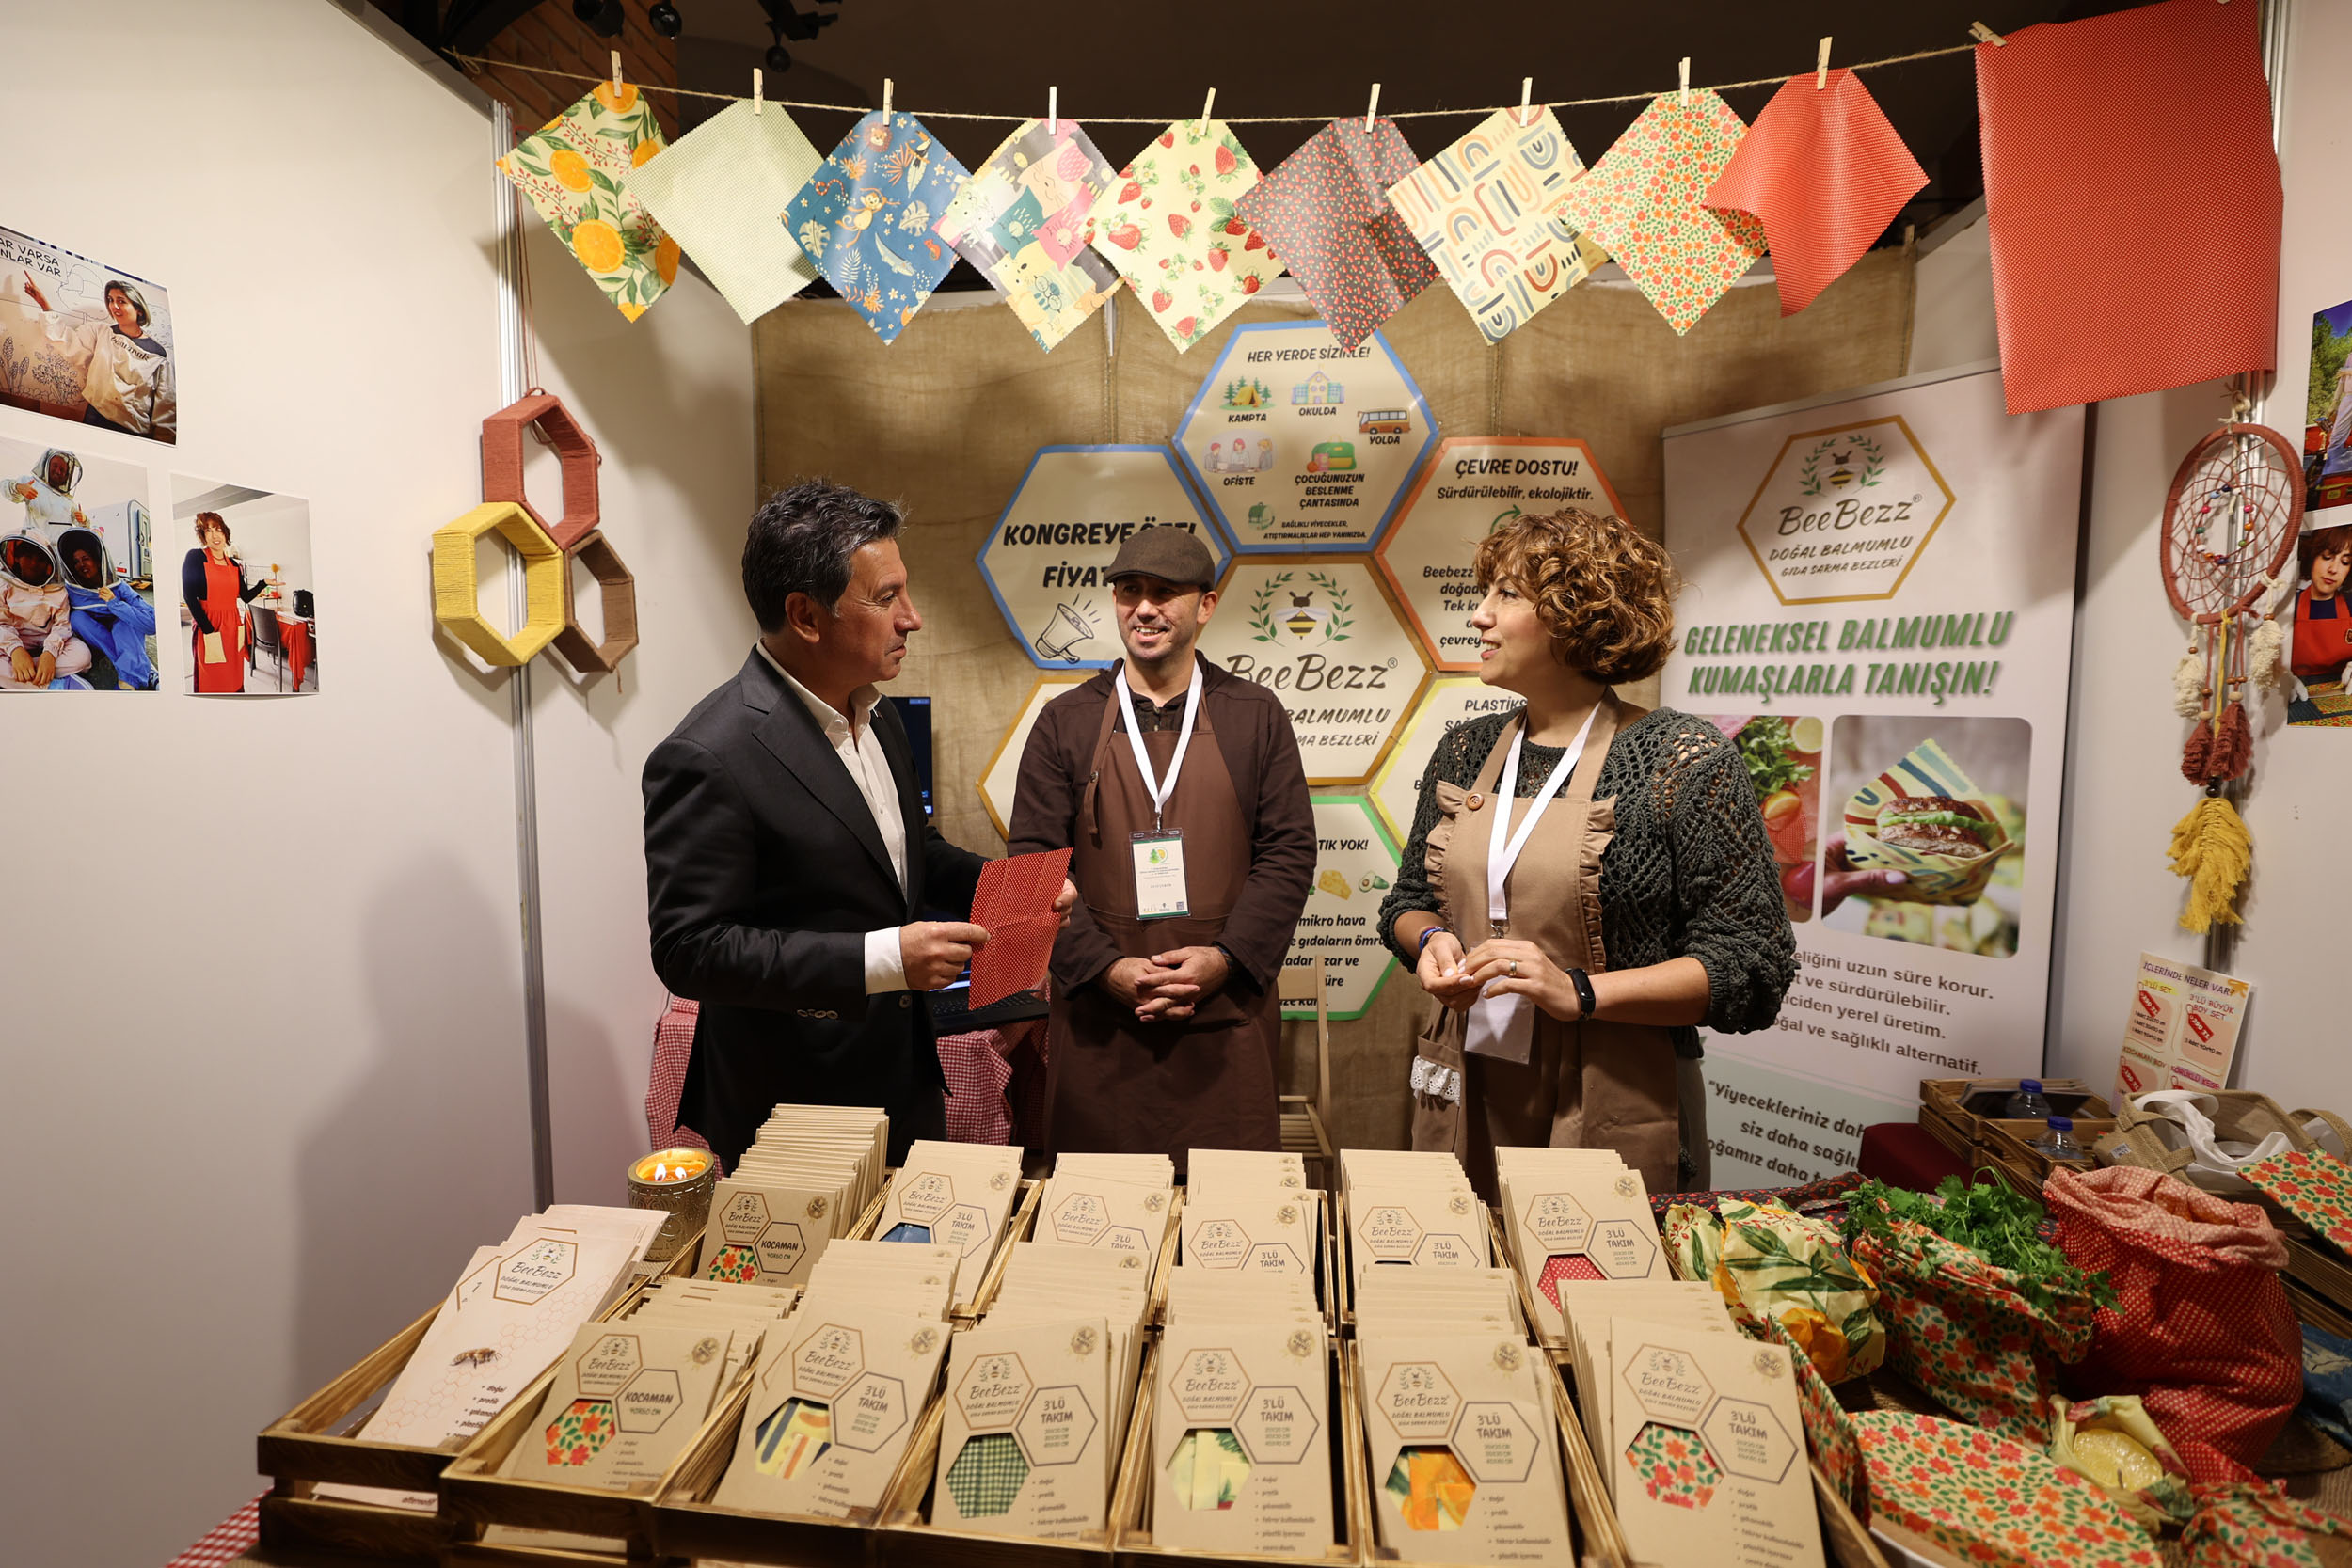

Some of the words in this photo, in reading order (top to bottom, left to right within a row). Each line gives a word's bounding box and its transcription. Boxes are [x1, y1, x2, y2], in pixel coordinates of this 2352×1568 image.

[18, 245, 59, 266] VARSA
[38, 262, 62, 277] VAR
[1248, 352, 1273, 363] HER
[1277, 349, 1316, 361] YERDE
[1228, 414, 1266, 423] KAMPTA
[1298, 407, 1337, 416] OKULDA
[1369, 436, 1401, 445] YOLDA
[1456, 459, 1512, 478] ÇEVRE
[1515, 460, 1579, 476] DOSTU!
[1223, 475, 1255, 486] OFİSTE
[1295, 472, 1365, 484] ÇOCUĞUNUZUN
[1305, 486, 1354, 496] BESLENME
[1438, 485, 1526, 500] Sürdürülebilir,
[1528, 486, 1594, 501] ekolojiktir.
[1299, 498, 1359, 509] ÇANTASINDA
[1003, 522, 1135, 546] KONGREYE
[1769, 544, 1817, 562] DOĞAL
[1820, 536, 1914, 557] BALMUMLU
[1423, 566, 1474, 578] Beebezz
[1781, 565, 1807, 577] GIDA
[1810, 562, 1847, 574] SARMA
[1851, 555, 1903, 571] BEZLERİ
[1443, 600, 1464, 611] Tek
[1684, 621, 1829, 655] GELENEKSEL
[1837, 611, 2014, 651] BALMUMLU
[1688, 664, 1855, 704] KUMAŞLARLA
[1864, 661, 2000, 705] TANIŞIN!
[1287, 708, 1391, 724] BALMUMLU
[1318, 732, 1380, 746] BEZLERİ
[1340, 840, 1369, 850] YOK!
[1298, 914, 1334, 927] mikro
[1336, 914, 1366, 926] hava
[1298, 935, 1352, 949] gıdaların
[1282, 955, 1313, 966] adar
[1345, 958, 1359, 966] ve
[1846, 961, 1887, 978] uzun
[1894, 969, 1932, 987] süre
[1939, 975, 1994, 999] korur.
[2184, 974, 2209, 988] NELER
[2212, 984, 2235, 996] VAR?
[1805, 976, 1823, 988] ve
[1829, 981, 1950, 1015] sürdürülebilir.
[2192, 1004, 2207, 1013] BOY
[2211, 1010, 2225, 1020] SET
[2209, 999, 2234, 1014] BÜYÜK
[1837, 1005, 1878, 1023] yerel
[1883, 1014, 1946, 1038] üretim.
[1808, 1024, 1826, 1037] ve
[1831, 1029, 1890, 1053] sağlıklı
[1896, 1044, 1982, 1075] alternatif.
[2153, 1058, 2166, 1068] BOY
[1740, 1120, 1764, 1137] siz
[1767, 1129, 1809, 1152] daha
[1767, 1157, 1809, 1182] daha
[909, 1191, 945, 1203] BeeBezz
[729, 1212, 762, 1223] BeeBezz
[1062, 1212, 1100, 1225] BeeBezz
[1538, 1217, 1581, 1227] BeeBezz
[952, 1221, 975, 1230] TAKIM
[1372, 1227, 1412, 1236] BeeBezz
[761, 1241, 798, 1251] KOCAMAN
[1201, 1240, 1241, 1249] BeeBezz
[1607, 1240, 1634, 1248] TAKIM
[512, 1262, 562, 1279] BeeBezz
[588, 1358, 631, 1370] BeeBezz
[805, 1351, 852, 1371] BeeBezz
[1185, 1378, 1238, 1392] BeeBezz
[1641, 1372, 1702, 1395] BeeBezz
[625, 1392, 674, 1404] KOCAMAN
[970, 1384, 1021, 1399] BeeBezz
[858, 1397, 888, 1414] TAKIM
[1393, 1393, 1449, 1407] BeeBezz
[1041, 1411, 1073, 1424] TAKIM
[1261, 1412, 1294, 1422] TAKIM
[1476, 1428, 1512, 1439] TAKIM
[1728, 1422, 1768, 1440] TAKIM
